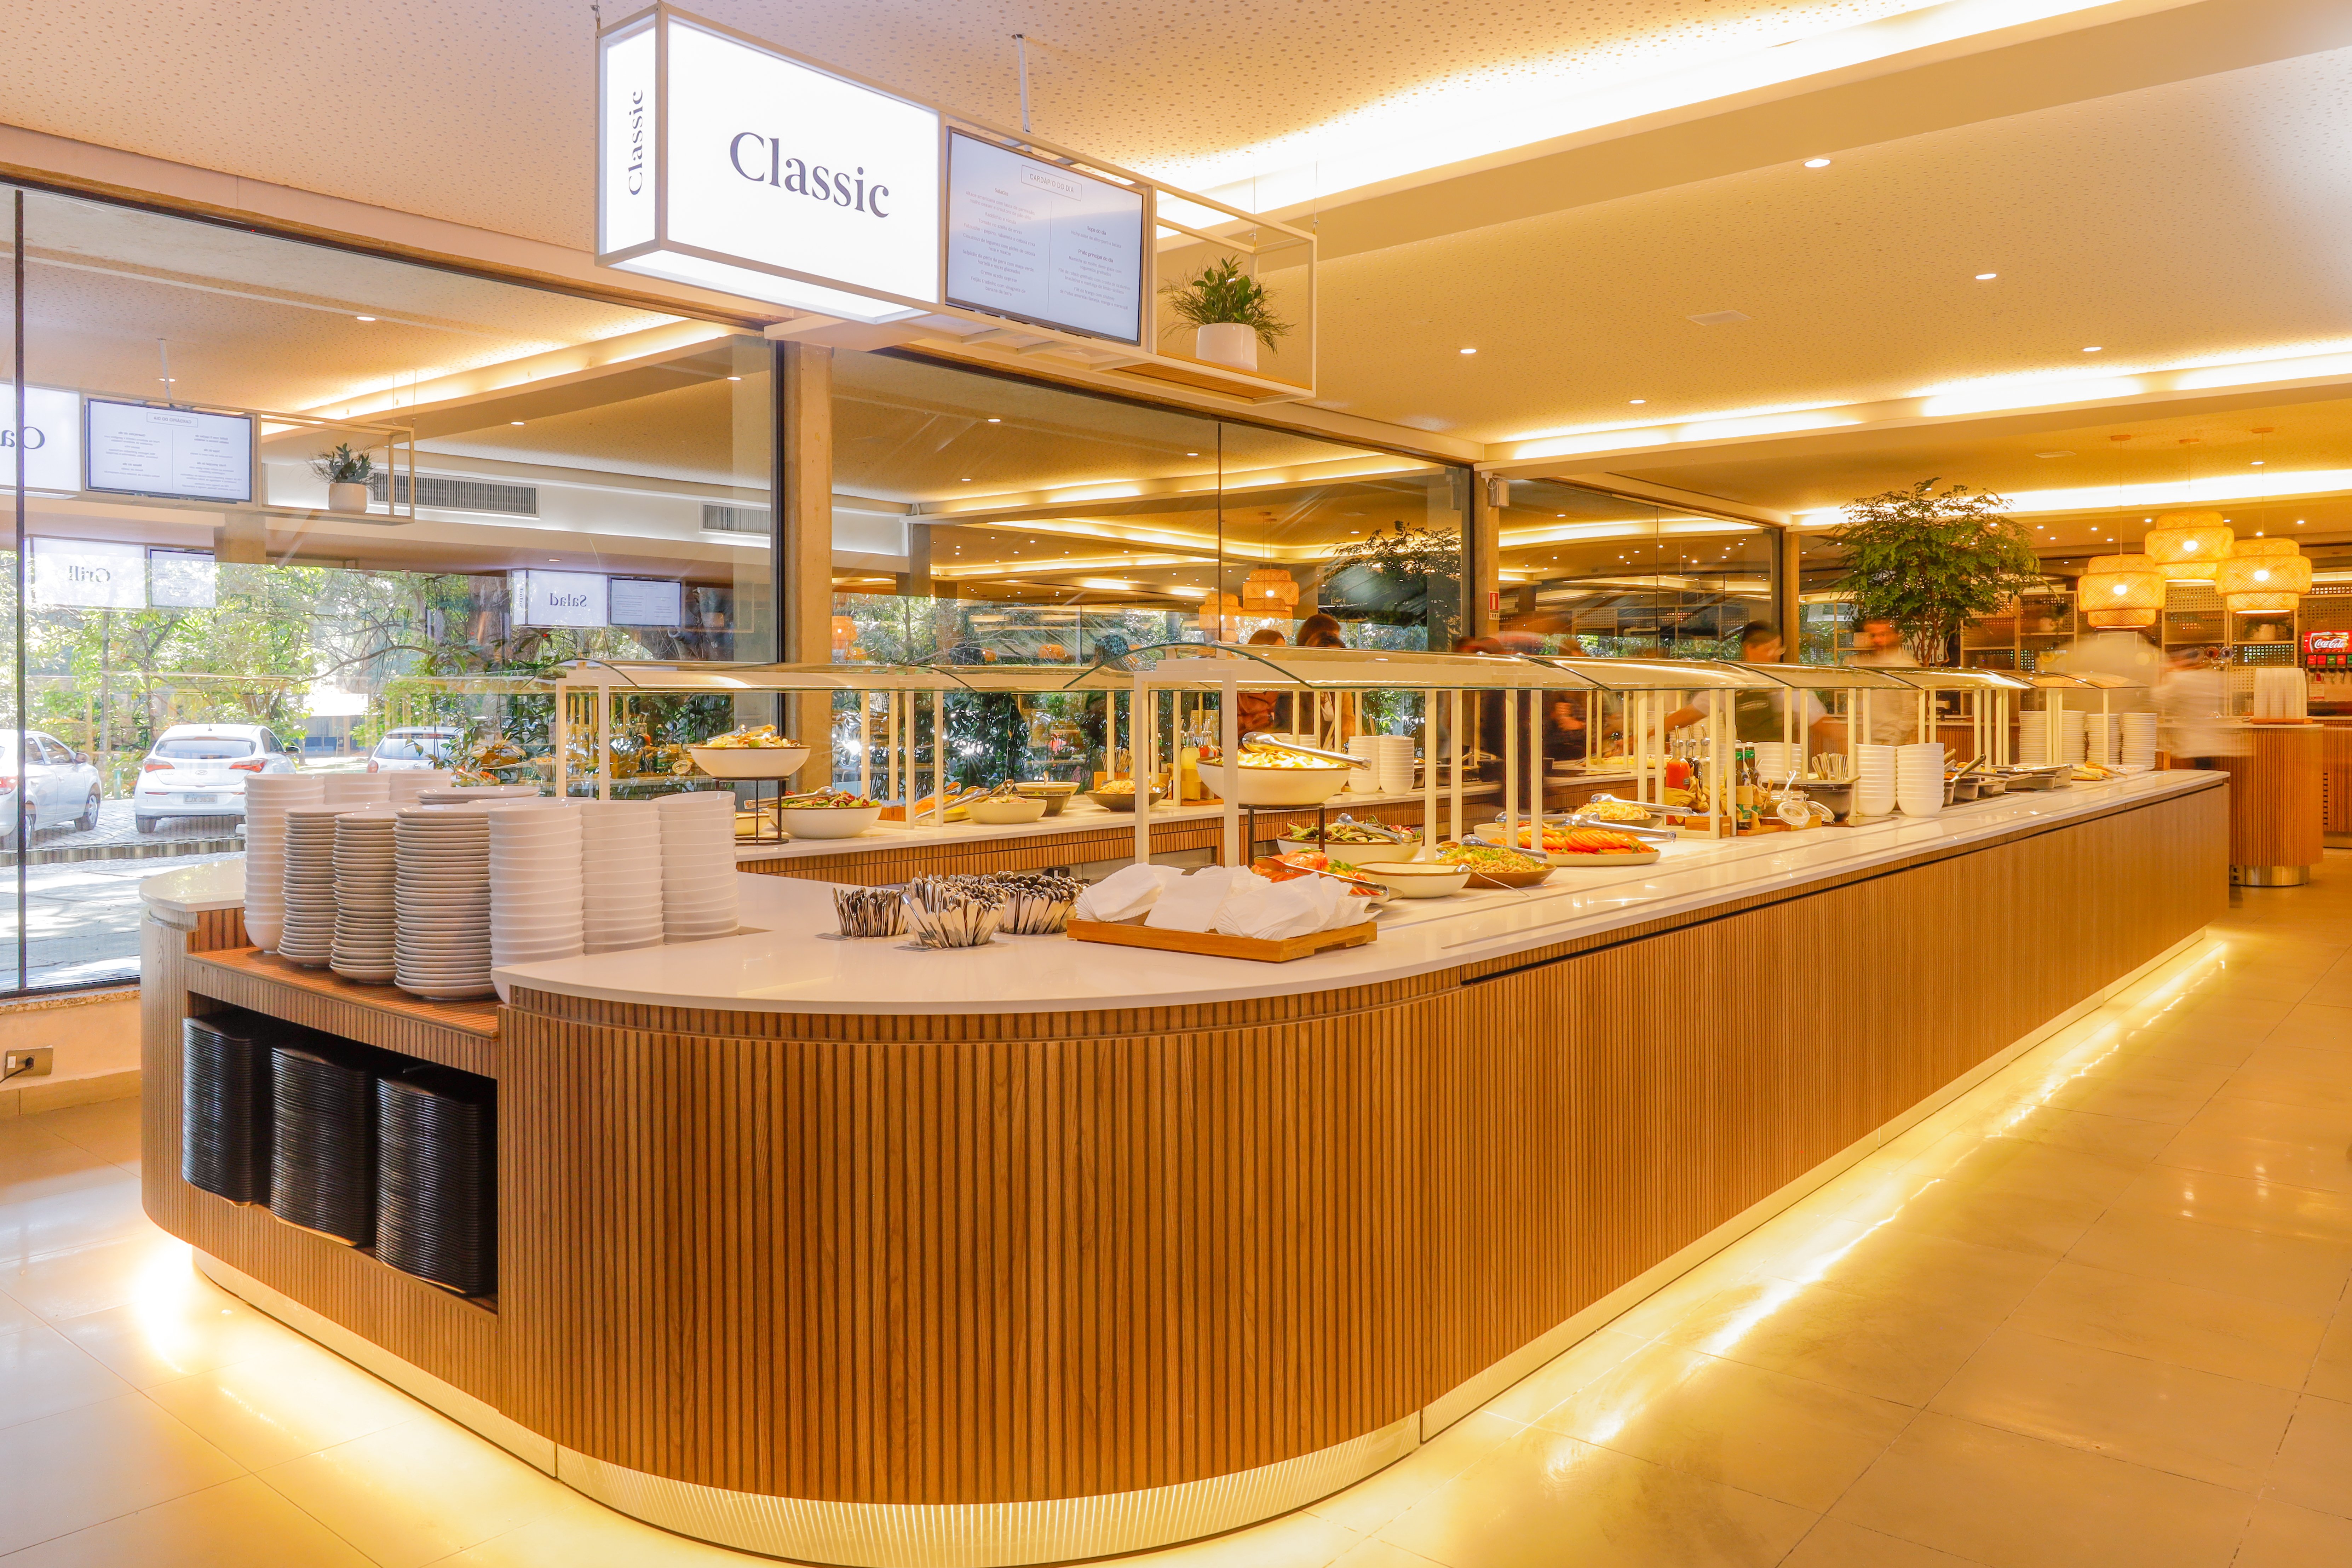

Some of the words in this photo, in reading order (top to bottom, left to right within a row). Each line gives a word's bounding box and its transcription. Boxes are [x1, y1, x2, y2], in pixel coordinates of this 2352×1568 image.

[628, 90, 643, 195] Classic
[730, 132, 889, 218] Classic
[1030, 173, 1056, 187] CARDÁPIO
[977, 195, 995, 203] americana
[964, 223, 980, 231] Fatouche
[2314, 638, 2345, 649] Coca-Cola
